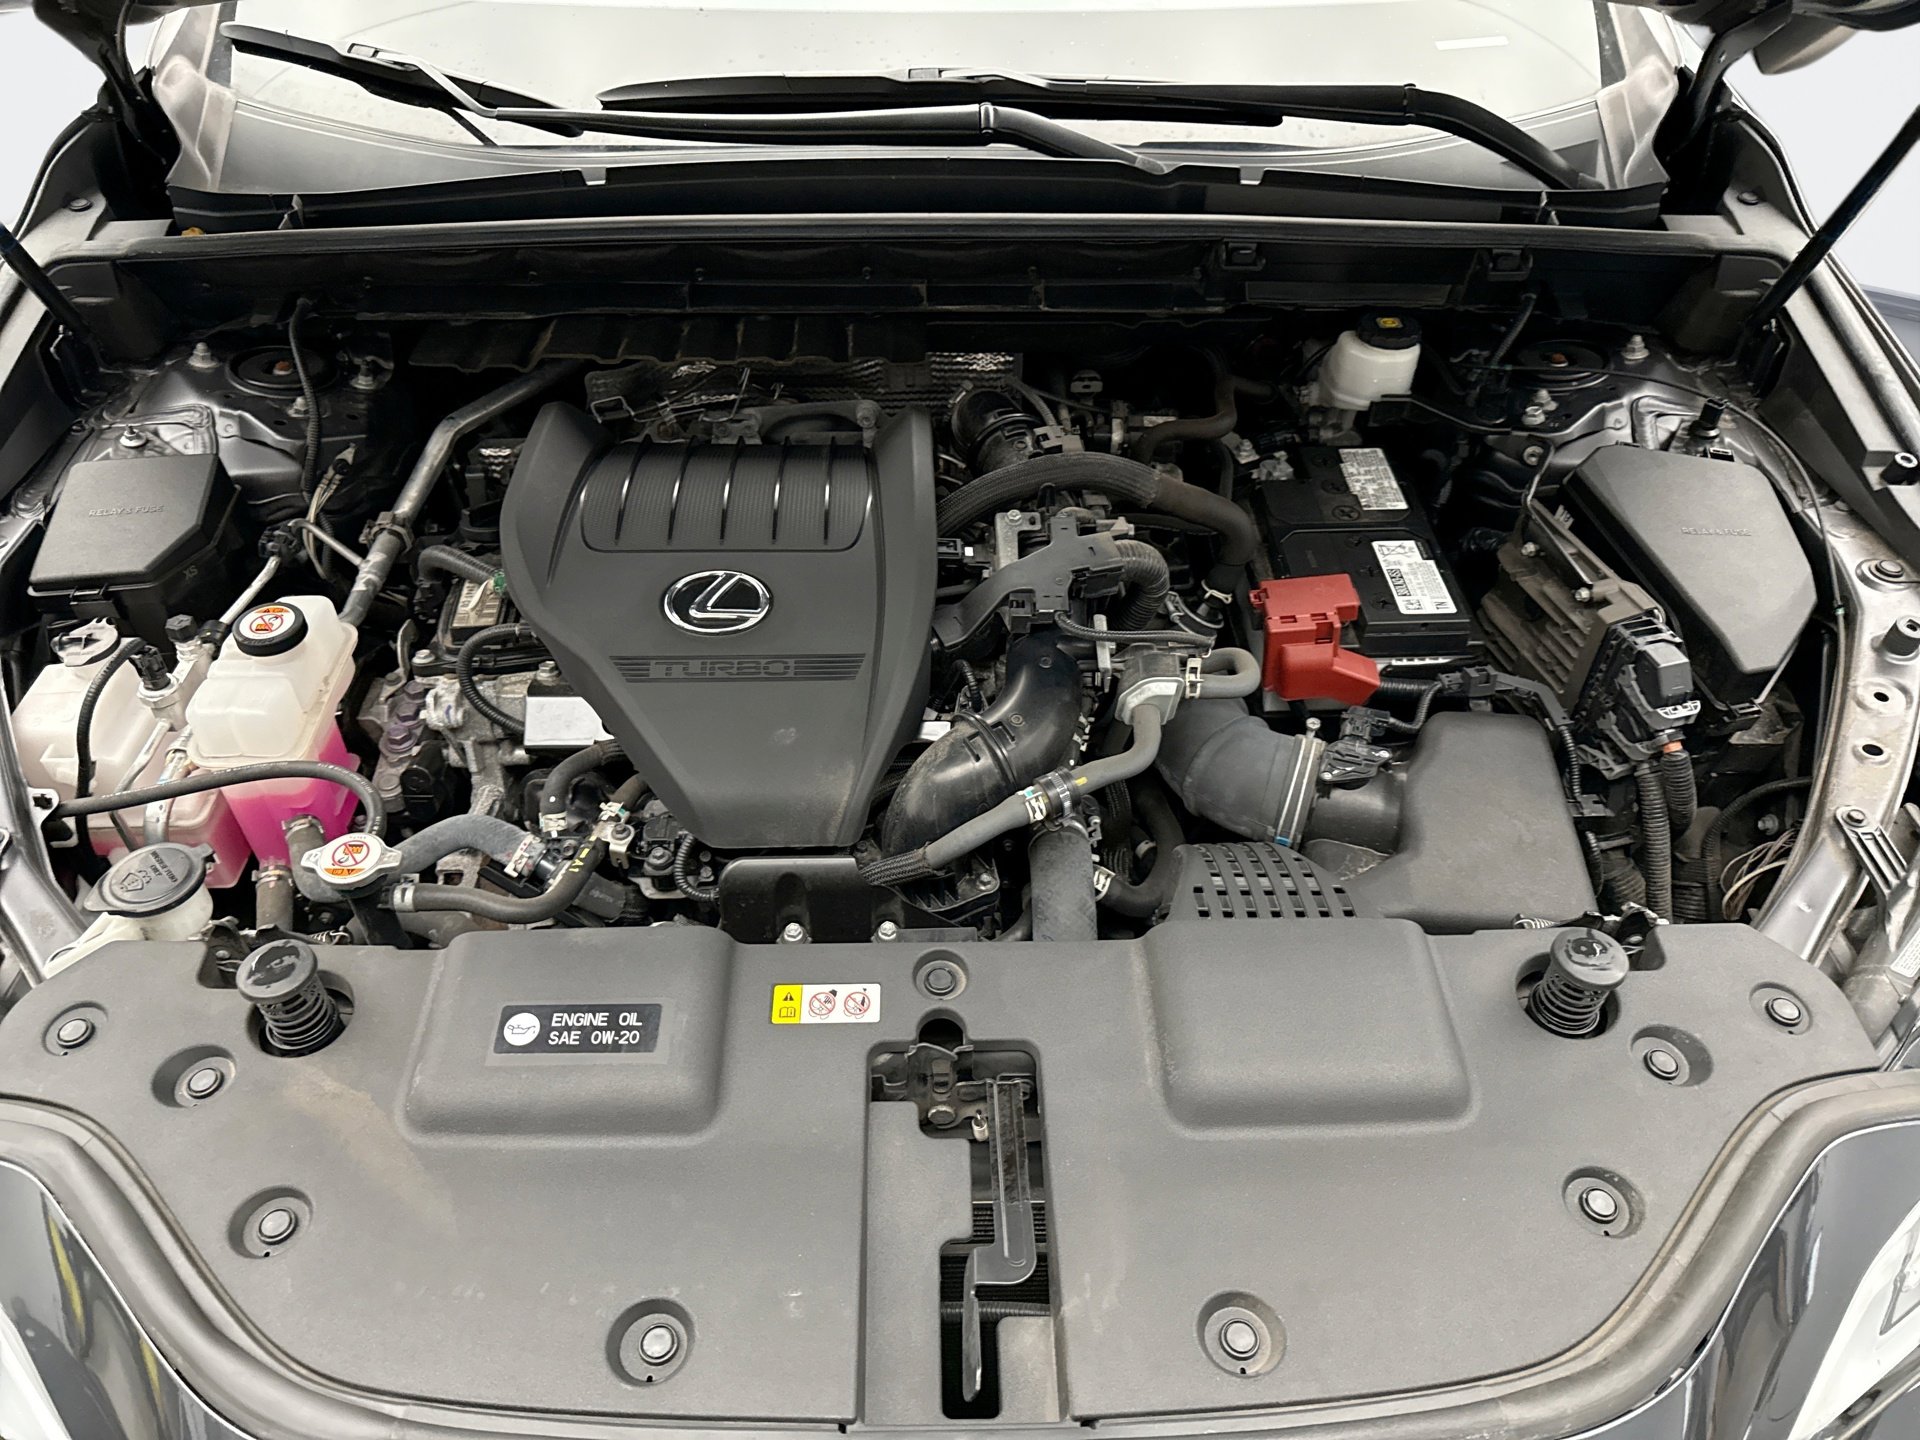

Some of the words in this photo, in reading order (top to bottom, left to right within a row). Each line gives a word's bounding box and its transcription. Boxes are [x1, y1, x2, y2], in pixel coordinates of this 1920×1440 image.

[88, 507, 125, 517] RELAY
[135, 505, 164, 514] FUSE
[653, 660, 791, 677] TURBO
[551, 1012, 609, 1027] ENGINE
[618, 1012, 643, 1026] OIL
[548, 1031, 581, 1045] SAE
[590, 1030, 640, 1045] 0W-20
